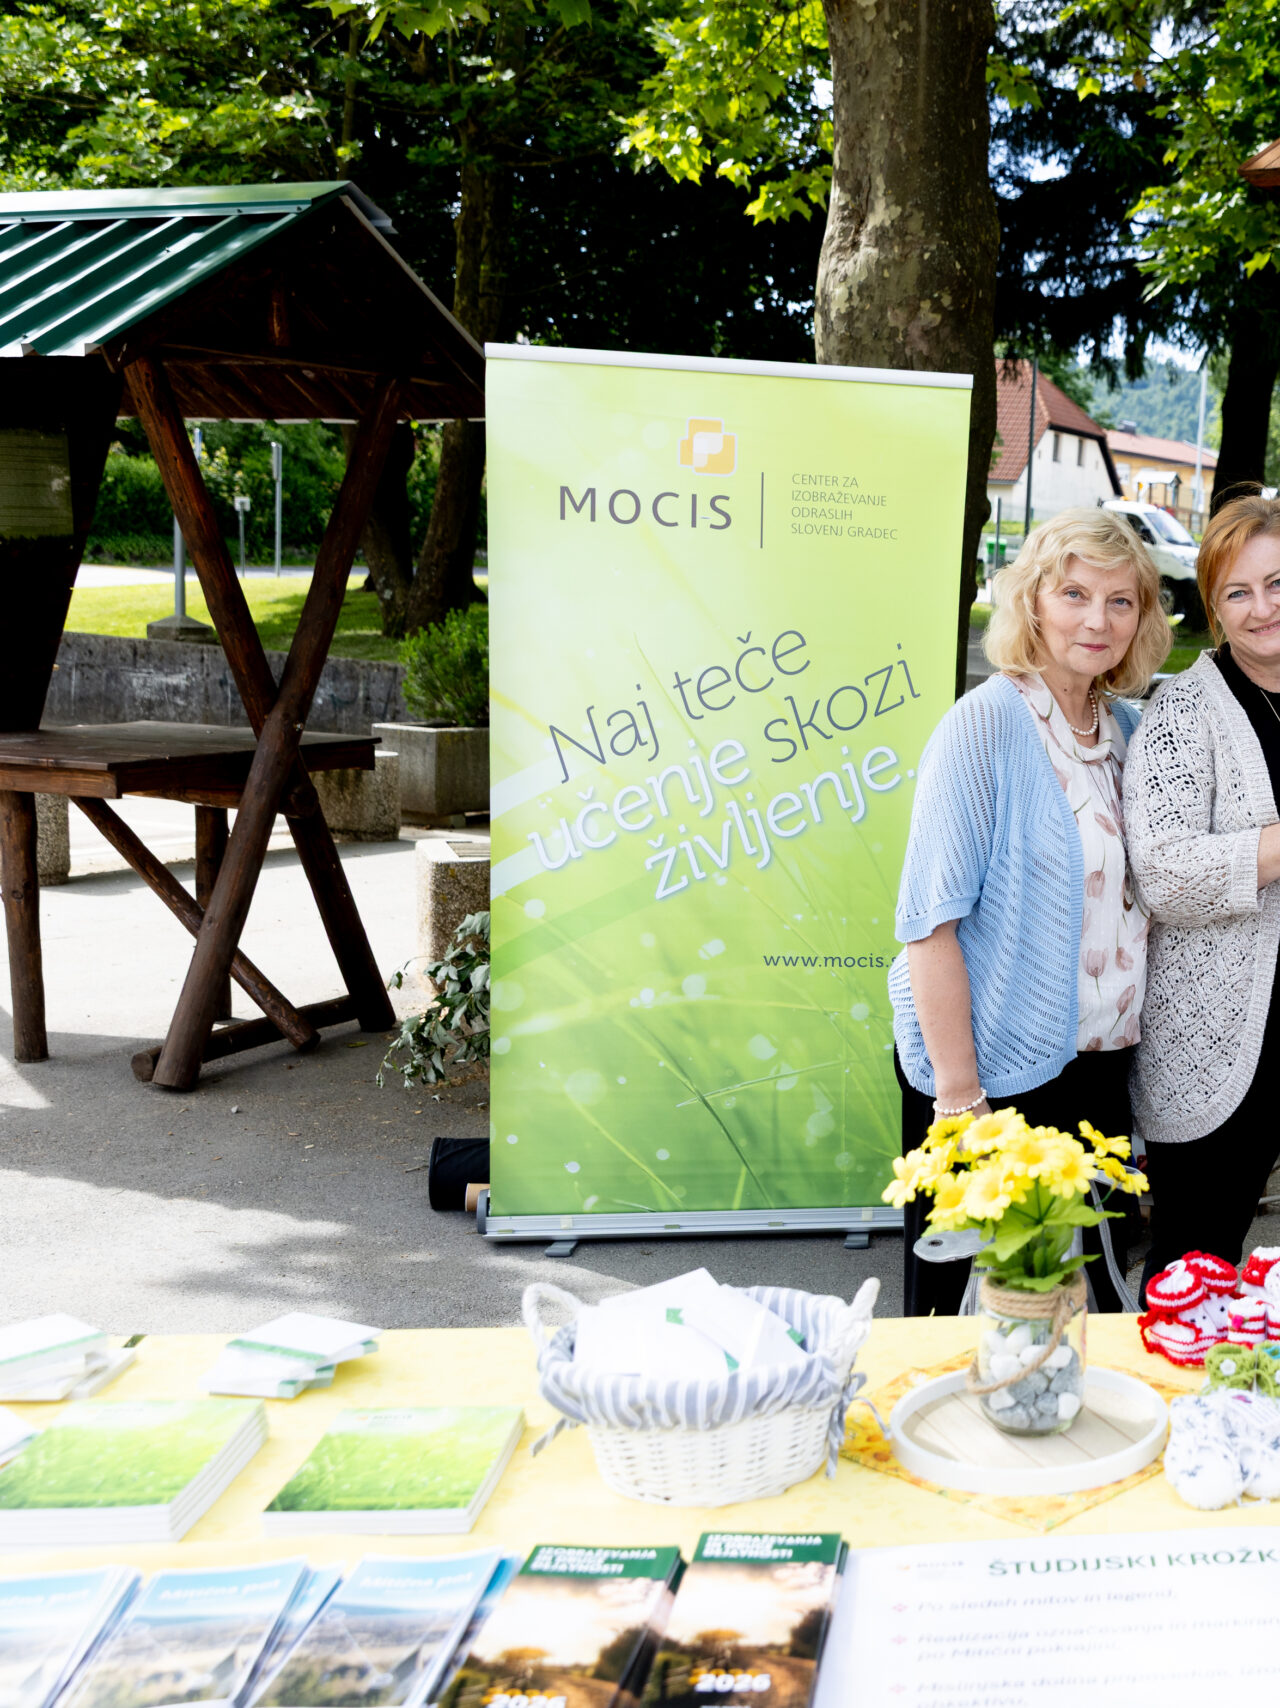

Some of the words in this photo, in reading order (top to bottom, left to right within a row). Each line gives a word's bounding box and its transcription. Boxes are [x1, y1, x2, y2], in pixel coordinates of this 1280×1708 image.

[791, 473, 839, 487] CENTER
[842, 476, 859, 488] ZA
[559, 485, 732, 531] MOCIS
[791, 489, 888, 507] IZOBRAŽEVANJE
[791, 506, 853, 521] ODRASLIH
[791, 523, 844, 537] SLOVENJ
[847, 526, 898, 540] GRADEC
[549, 683, 660, 784] Naj
[672, 629, 811, 721] teče
[527, 738, 750, 870] učenje
[763, 643, 921, 763] skozi
[644, 745, 916, 900] življenje.
[988, 1554, 1156, 1576] ŠTUDIJSKI
[693, 1674, 771, 1692] 2026
